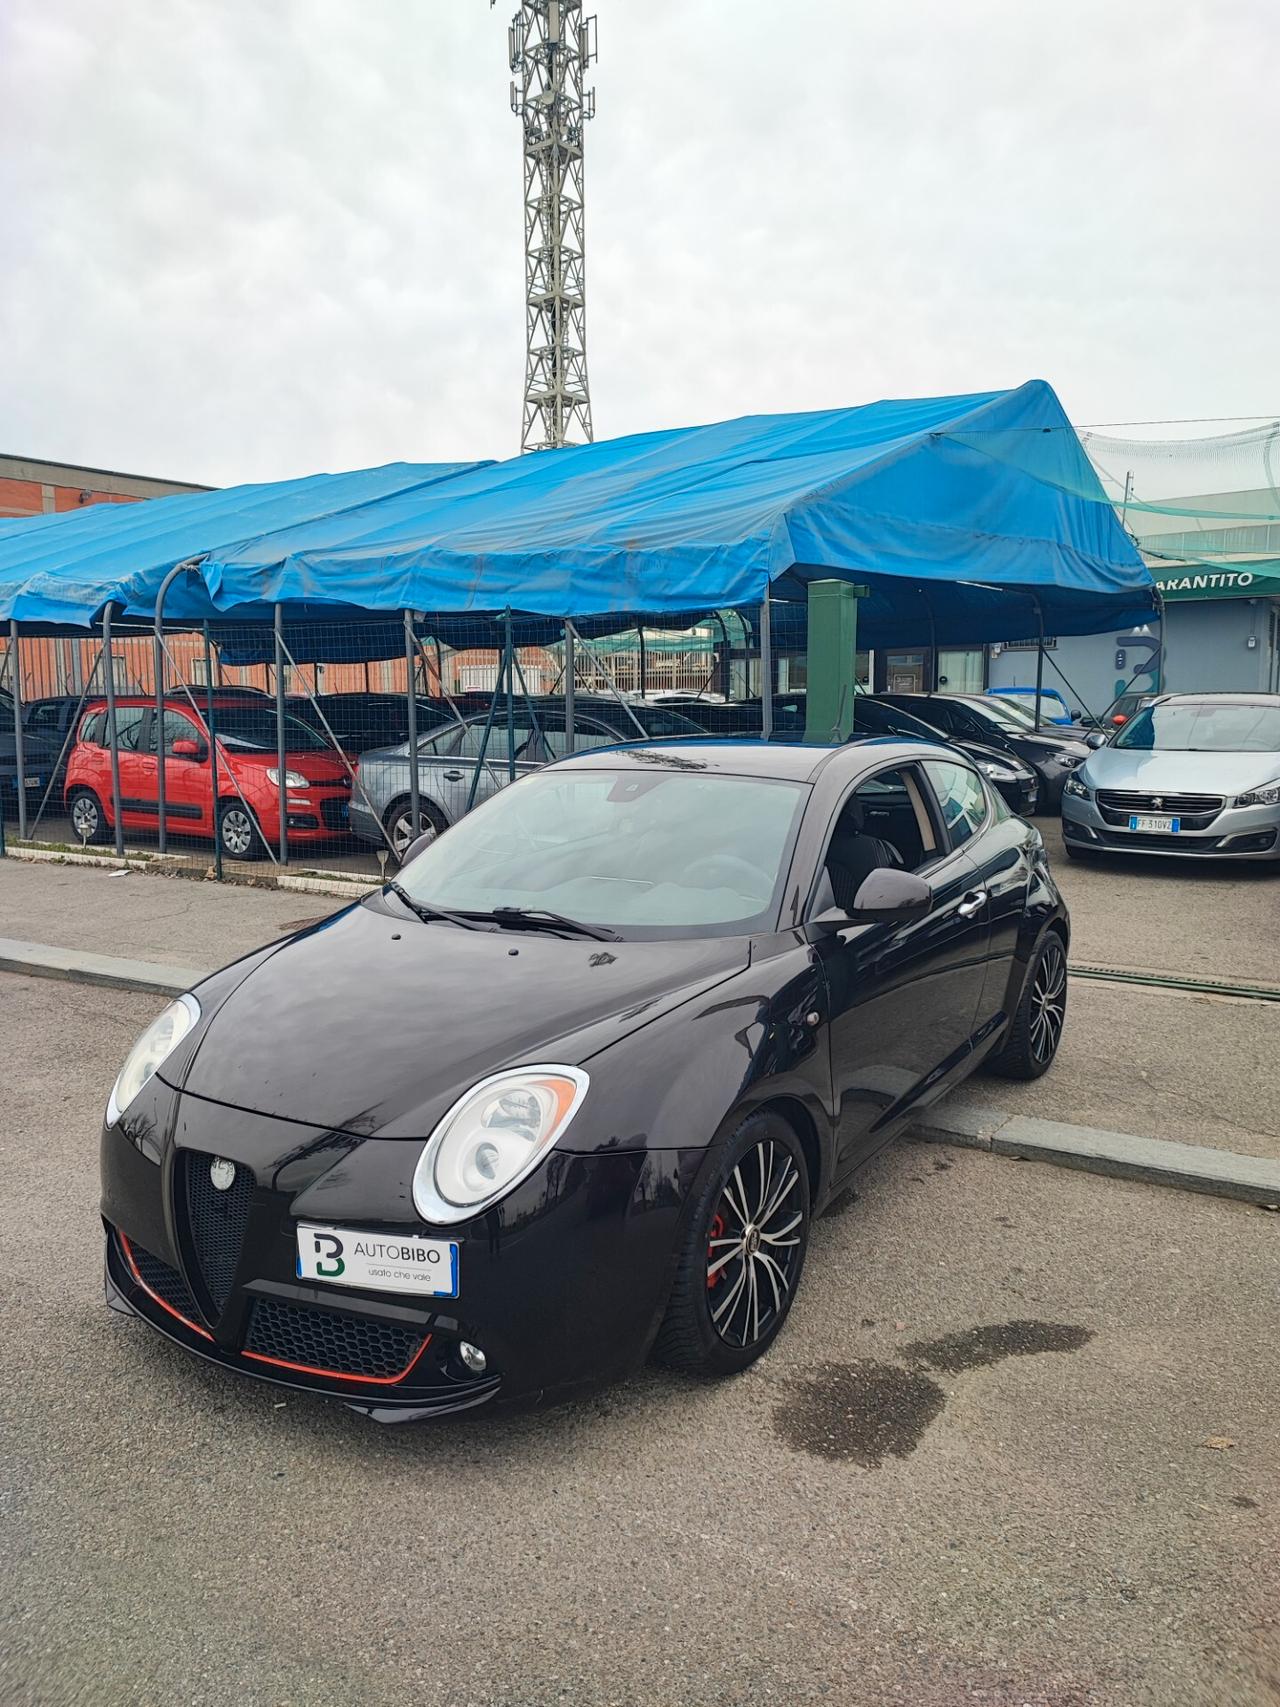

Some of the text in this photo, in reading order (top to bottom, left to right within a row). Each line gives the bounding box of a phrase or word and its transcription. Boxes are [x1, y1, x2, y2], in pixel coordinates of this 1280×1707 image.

[1155, 572, 1253, 591] ARANTITO
[354, 1242, 441, 1263] AUTOBIBO
[368, 1268, 431, 1282] usato che vale
